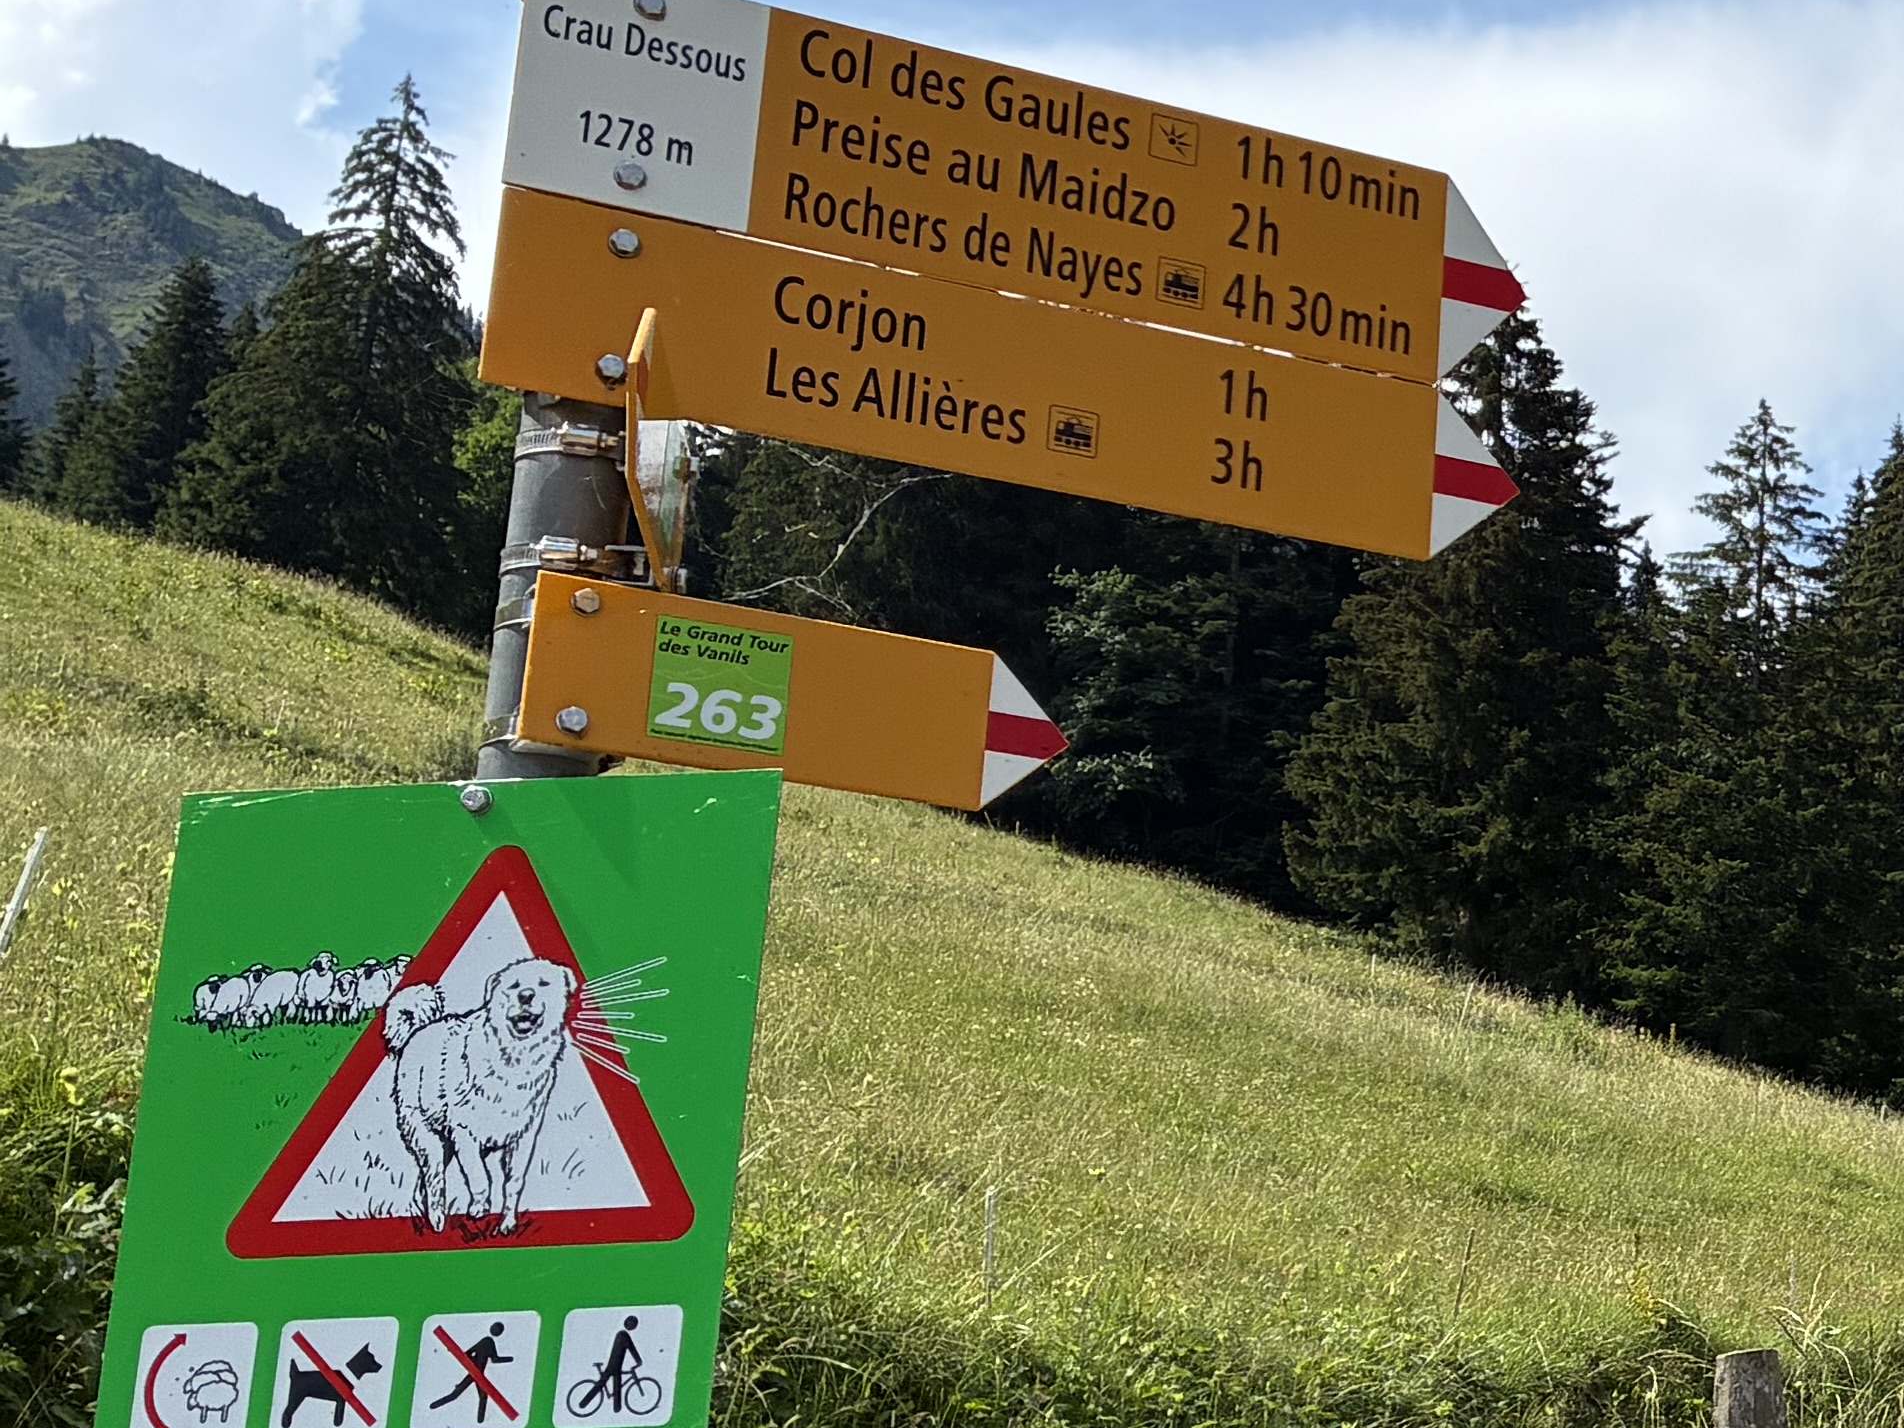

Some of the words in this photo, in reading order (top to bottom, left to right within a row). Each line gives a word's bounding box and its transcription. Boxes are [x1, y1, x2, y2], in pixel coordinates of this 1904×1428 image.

[543, 4, 613, 51] Crau
[625, 23, 746, 82] Dessous
[579, 110, 655, 157] 1278
[666, 139, 694, 166] m
[801, 29, 873, 89] Col
[891, 50, 966, 110] des
[984, 75, 1130, 151] Gaules
[1237, 135, 1284, 188] 1h
[792, 98, 930, 176] Preise
[947, 149, 1000, 193] au
[1018, 152, 1175, 232] Maidzo
[1228, 202, 1279, 256] 2h
[784, 172, 948, 253] Rochers
[963, 212, 1011, 267] de
[1026, 226, 1143, 299] Nayes
[1222, 273, 1274, 325] 4h
[774, 275, 926, 351] Corjon
[1218, 368, 1269, 423] 1h
[765, 347, 840, 408] Les
[851, 367, 1026, 445] Allières
[1210, 438, 1263, 492] 3h
[658, 639, 691, 656] des
[697, 644, 750, 665] Vanils
[659, 621, 681, 637] Le
[687, 625, 744, 647] Grand
[749, 635, 789, 654] Tour
[654, 682, 783, 740] 263
